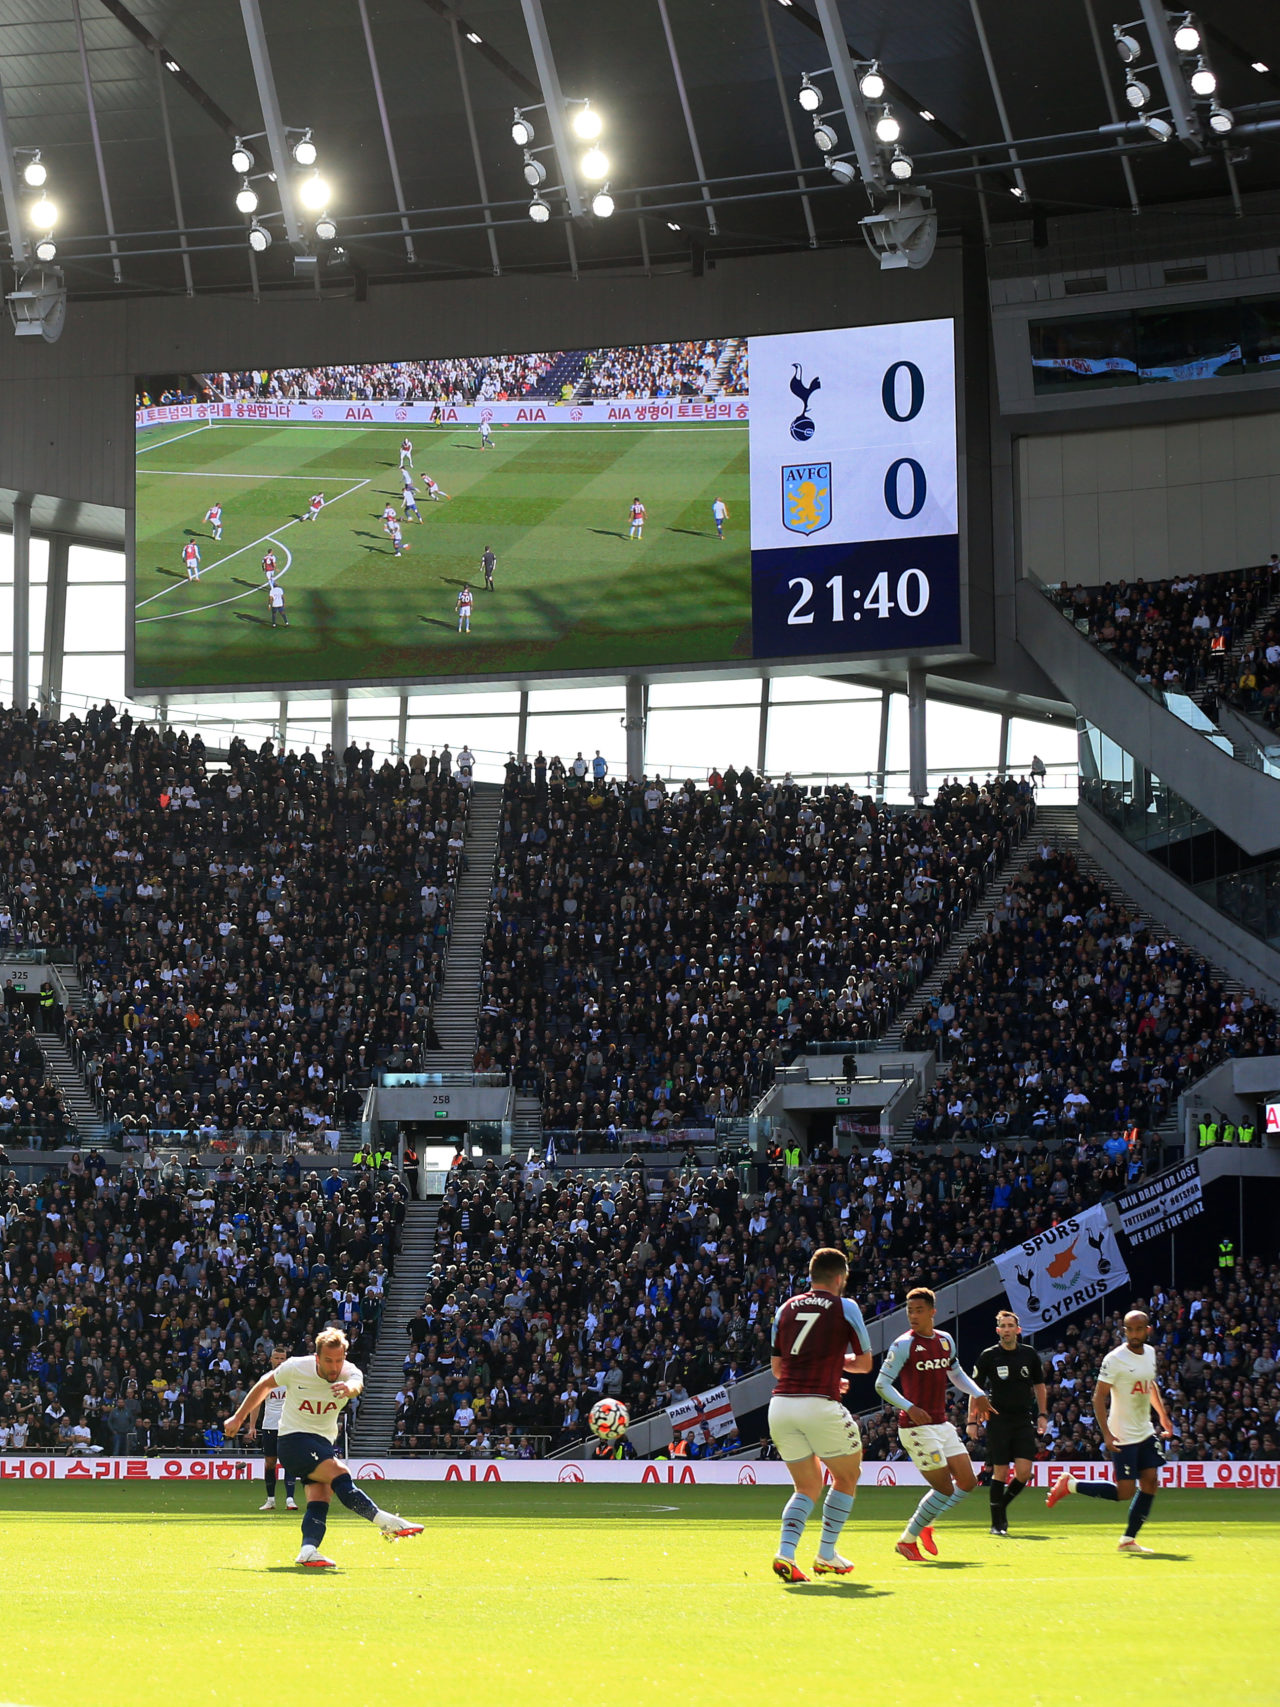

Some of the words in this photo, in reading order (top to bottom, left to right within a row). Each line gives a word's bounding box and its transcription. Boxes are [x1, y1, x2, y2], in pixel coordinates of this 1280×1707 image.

[882, 361, 925, 422] 0
[235, 403, 291, 418] 응원합니다
[345, 407, 374, 420] AIA
[516, 408, 546, 421] AIA
[608, 408, 631, 420] AIA
[634, 405, 673, 420] 생명이
[677, 404, 732, 419] 토트넘의
[786, 466, 828, 482] AVFC
[884, 457, 927, 520] 0
[787, 568, 930, 625] 21:40
[12, 971, 28, 980] 325
[835, 1086, 852, 1095] 259
[432, 1095, 450, 1104] 258
[1119, 1193, 1138, 1210] WIN
[1138, 1182, 1164, 1201] DRAW
[1164, 1175, 1176, 1189] OR
[1176, 1164, 1197, 1182] LOSE
[1022, 1218, 1080, 1257] SPURS
[1129, 1232, 1144, 1247] WE
[1165, 1213, 1183, 1229] THE
[1041, 1278, 1108, 1323] CYPRUS
[790, 1312, 821, 1355] 7
[915, 1358, 950, 1371] CAZO
[1130, 1380, 1152, 1395] AI
[298, 1400, 338, 1415] AIA
[670, 1404, 691, 1419] PARK
[705, 1390, 726, 1404] LANE
[444, 1464, 502, 1482] AIA
[641, 1465, 696, 1484] AIA
